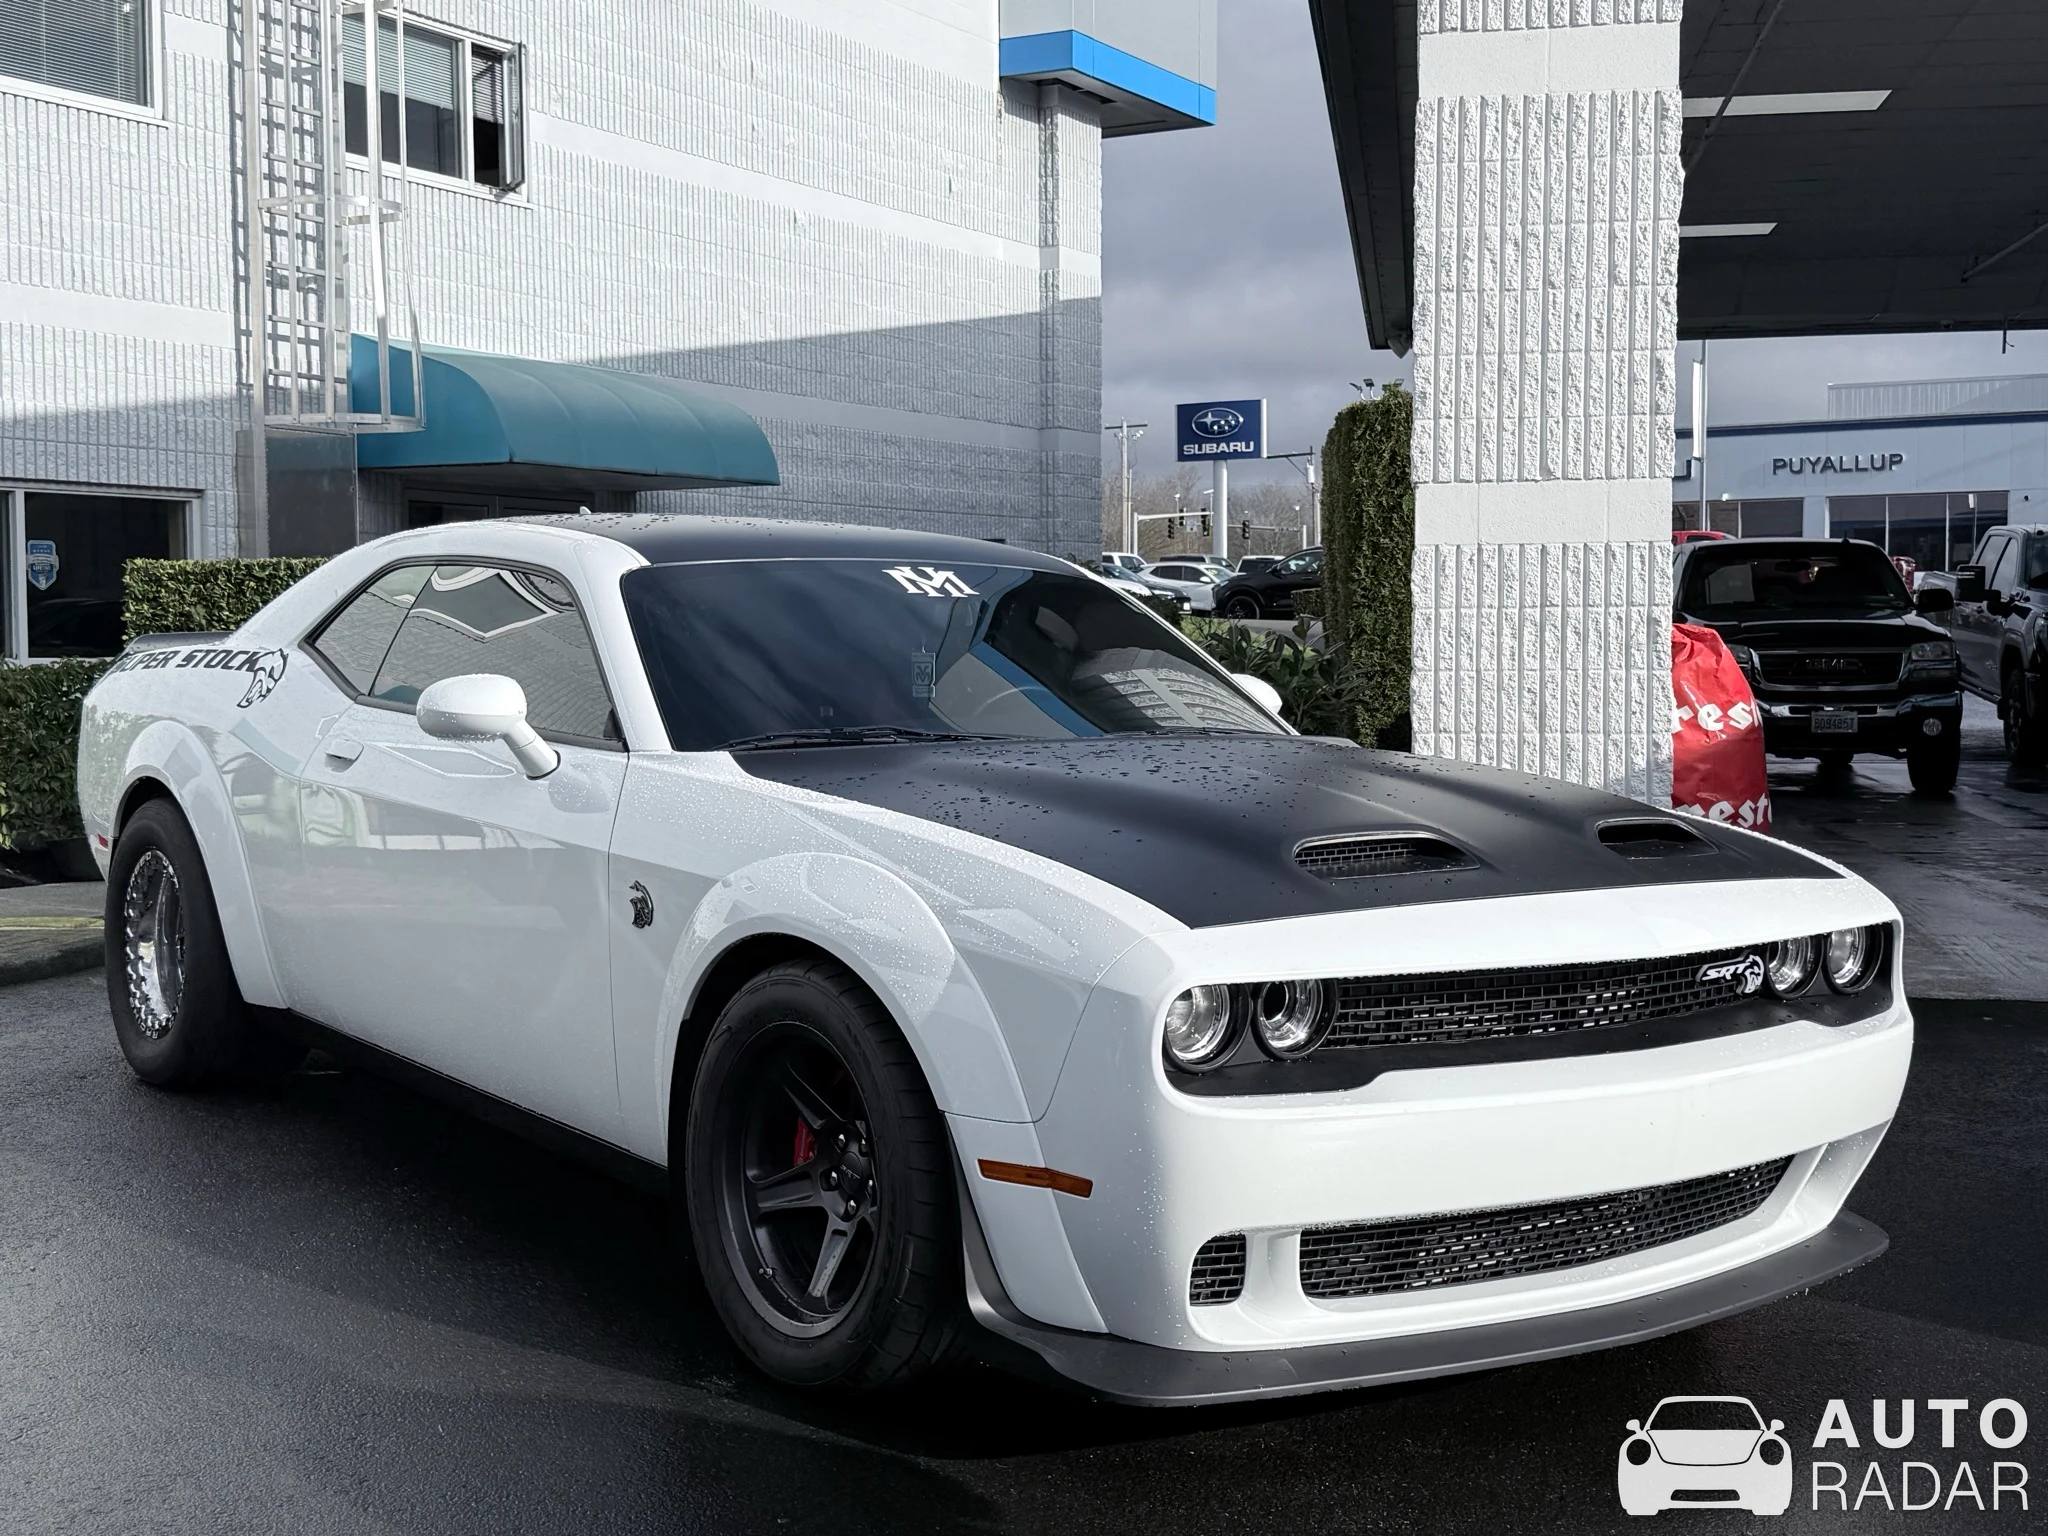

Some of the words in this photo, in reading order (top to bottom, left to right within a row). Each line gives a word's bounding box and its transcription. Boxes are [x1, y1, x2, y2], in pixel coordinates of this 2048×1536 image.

[1183, 441, 1254, 455] SUBARU
[1772, 453, 1904, 475] PUYALLUP
[175, 649, 264, 673] STOCK
[1701, 962, 1751, 981] SRT
